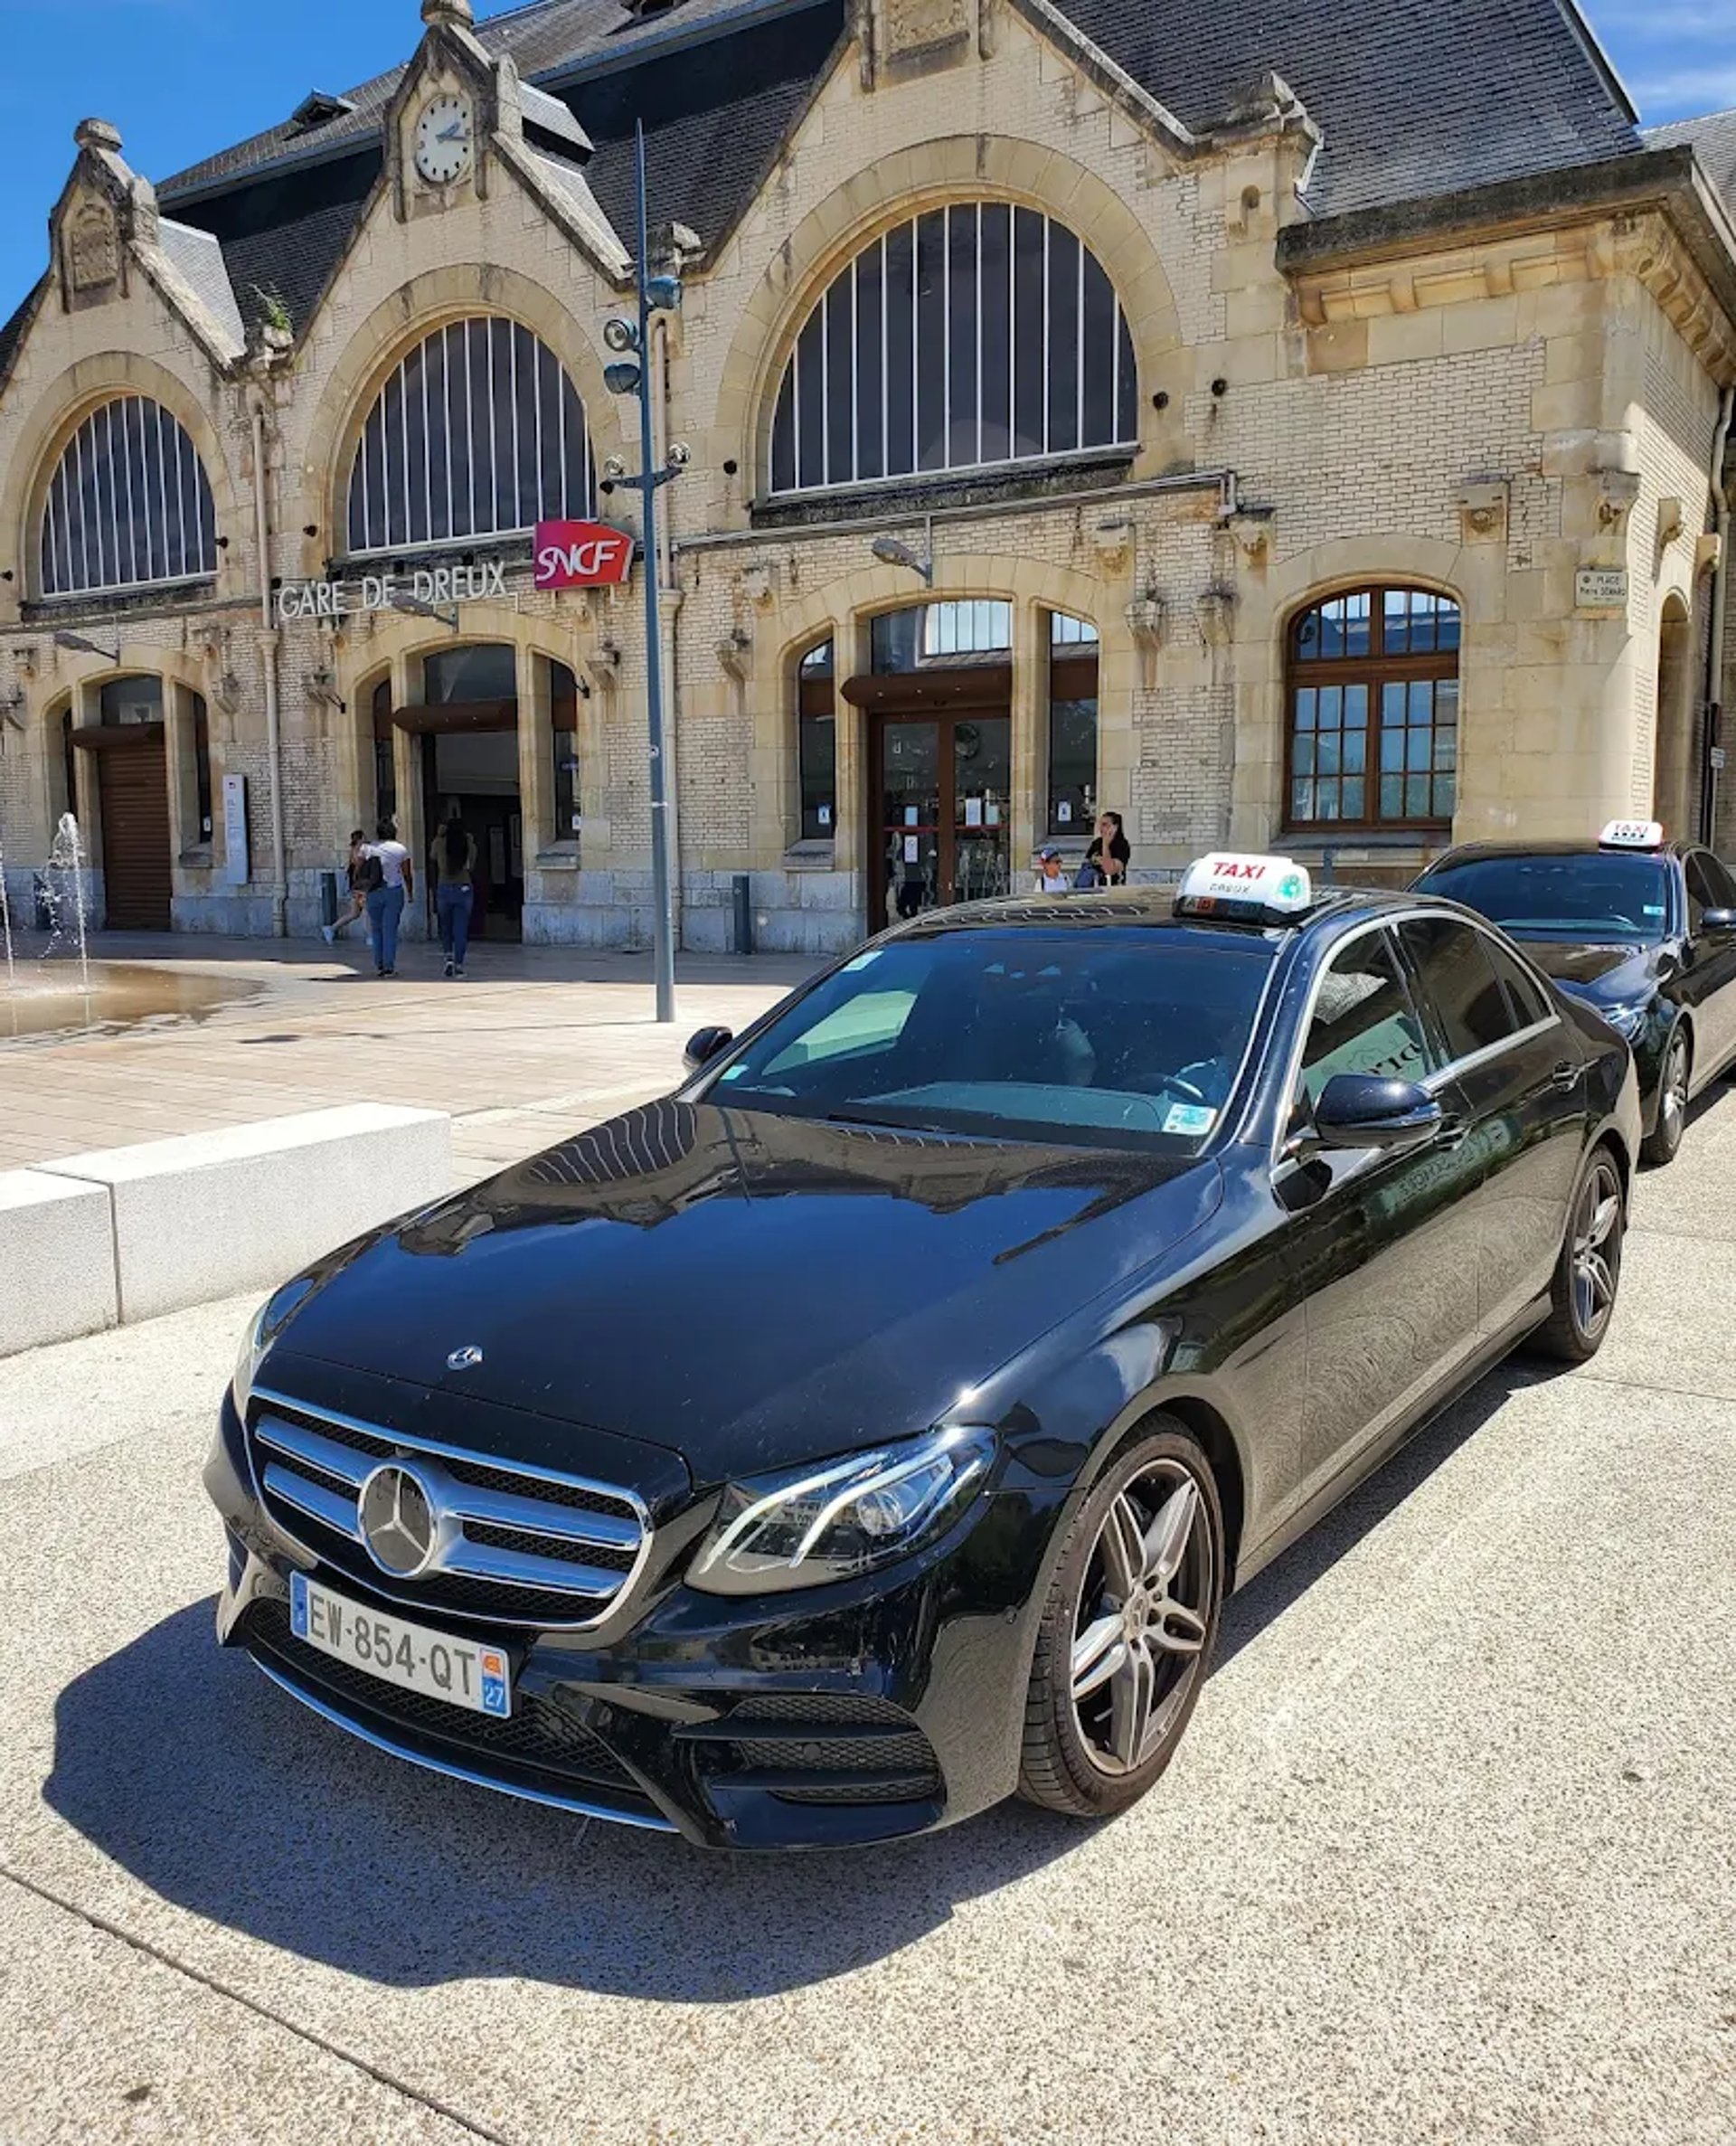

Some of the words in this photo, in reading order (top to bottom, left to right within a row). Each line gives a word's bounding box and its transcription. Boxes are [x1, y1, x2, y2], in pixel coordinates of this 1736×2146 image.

[535, 540, 622, 581] SNCF
[278, 579, 346, 618] GARE
[362, 574, 397, 608] DE
[412, 561, 507, 604] DREUX
[1212, 862, 1266, 880] TAXI
[308, 1592, 476, 1696] EW-854-QT
[485, 1684, 505, 1707] 27
